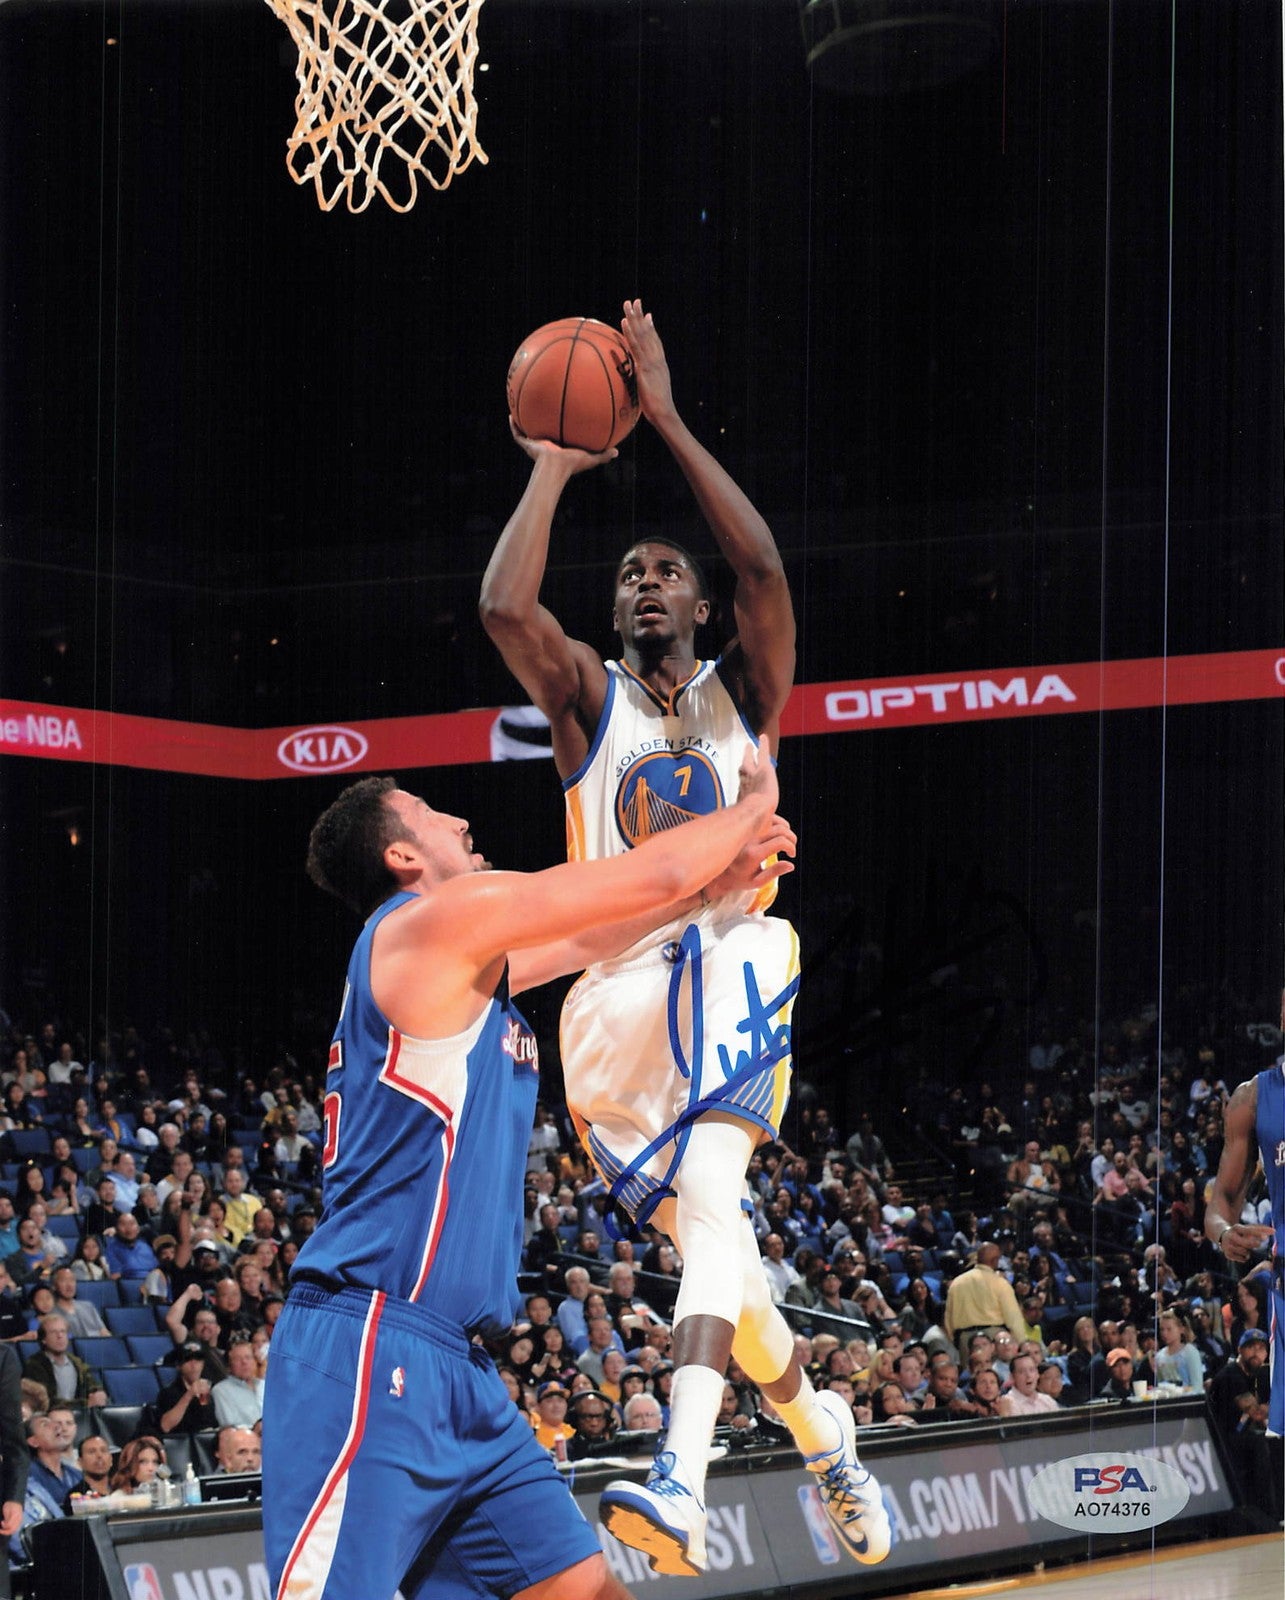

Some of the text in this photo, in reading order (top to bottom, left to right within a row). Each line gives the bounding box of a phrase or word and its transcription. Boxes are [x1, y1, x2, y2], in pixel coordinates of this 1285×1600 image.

[825, 674, 1077, 721] OPTIMA
[0, 713, 83, 751] e NBA
[293, 735, 355, 764] KIA
[616, 736, 720, 778] GOLDEN STATE
[673, 764, 692, 797] 7
